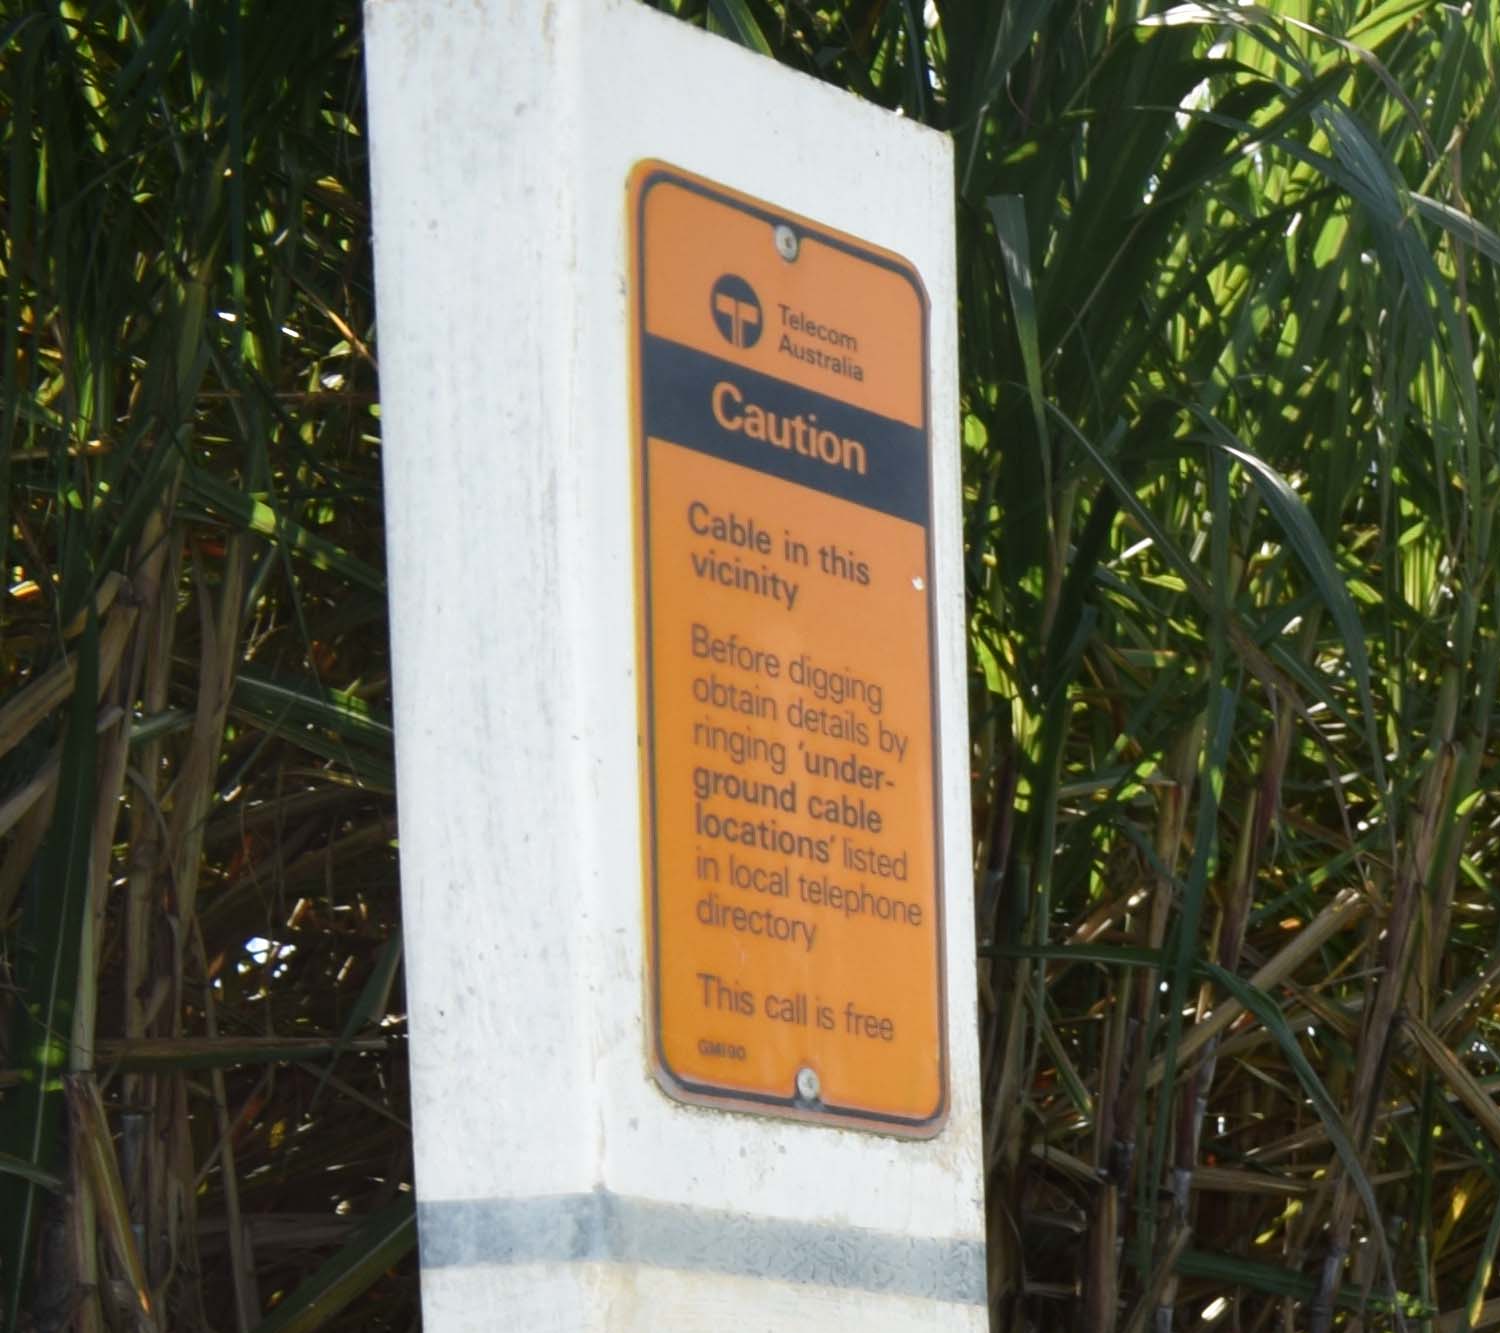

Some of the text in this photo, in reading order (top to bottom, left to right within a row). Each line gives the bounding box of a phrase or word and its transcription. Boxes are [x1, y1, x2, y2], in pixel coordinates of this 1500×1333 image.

[779, 304, 858, 351] Telecom
[779, 337, 864, 381] Australia
[712, 381, 867, 475] Caution
[688, 500, 870, 586] Cable in this
[691, 550, 798, 611] vicinity
[691, 624, 882, 715] Before digging
[693, 675, 909, 762] obtain details by
[694, 719, 786, 774] ringing
[694, 766, 882, 833] ground cable
[695, 847, 922, 927] in local telephone
[844, 838, 908, 882] listed
[696, 897, 817, 952] directory
[697, 973, 894, 1041] This call is free
